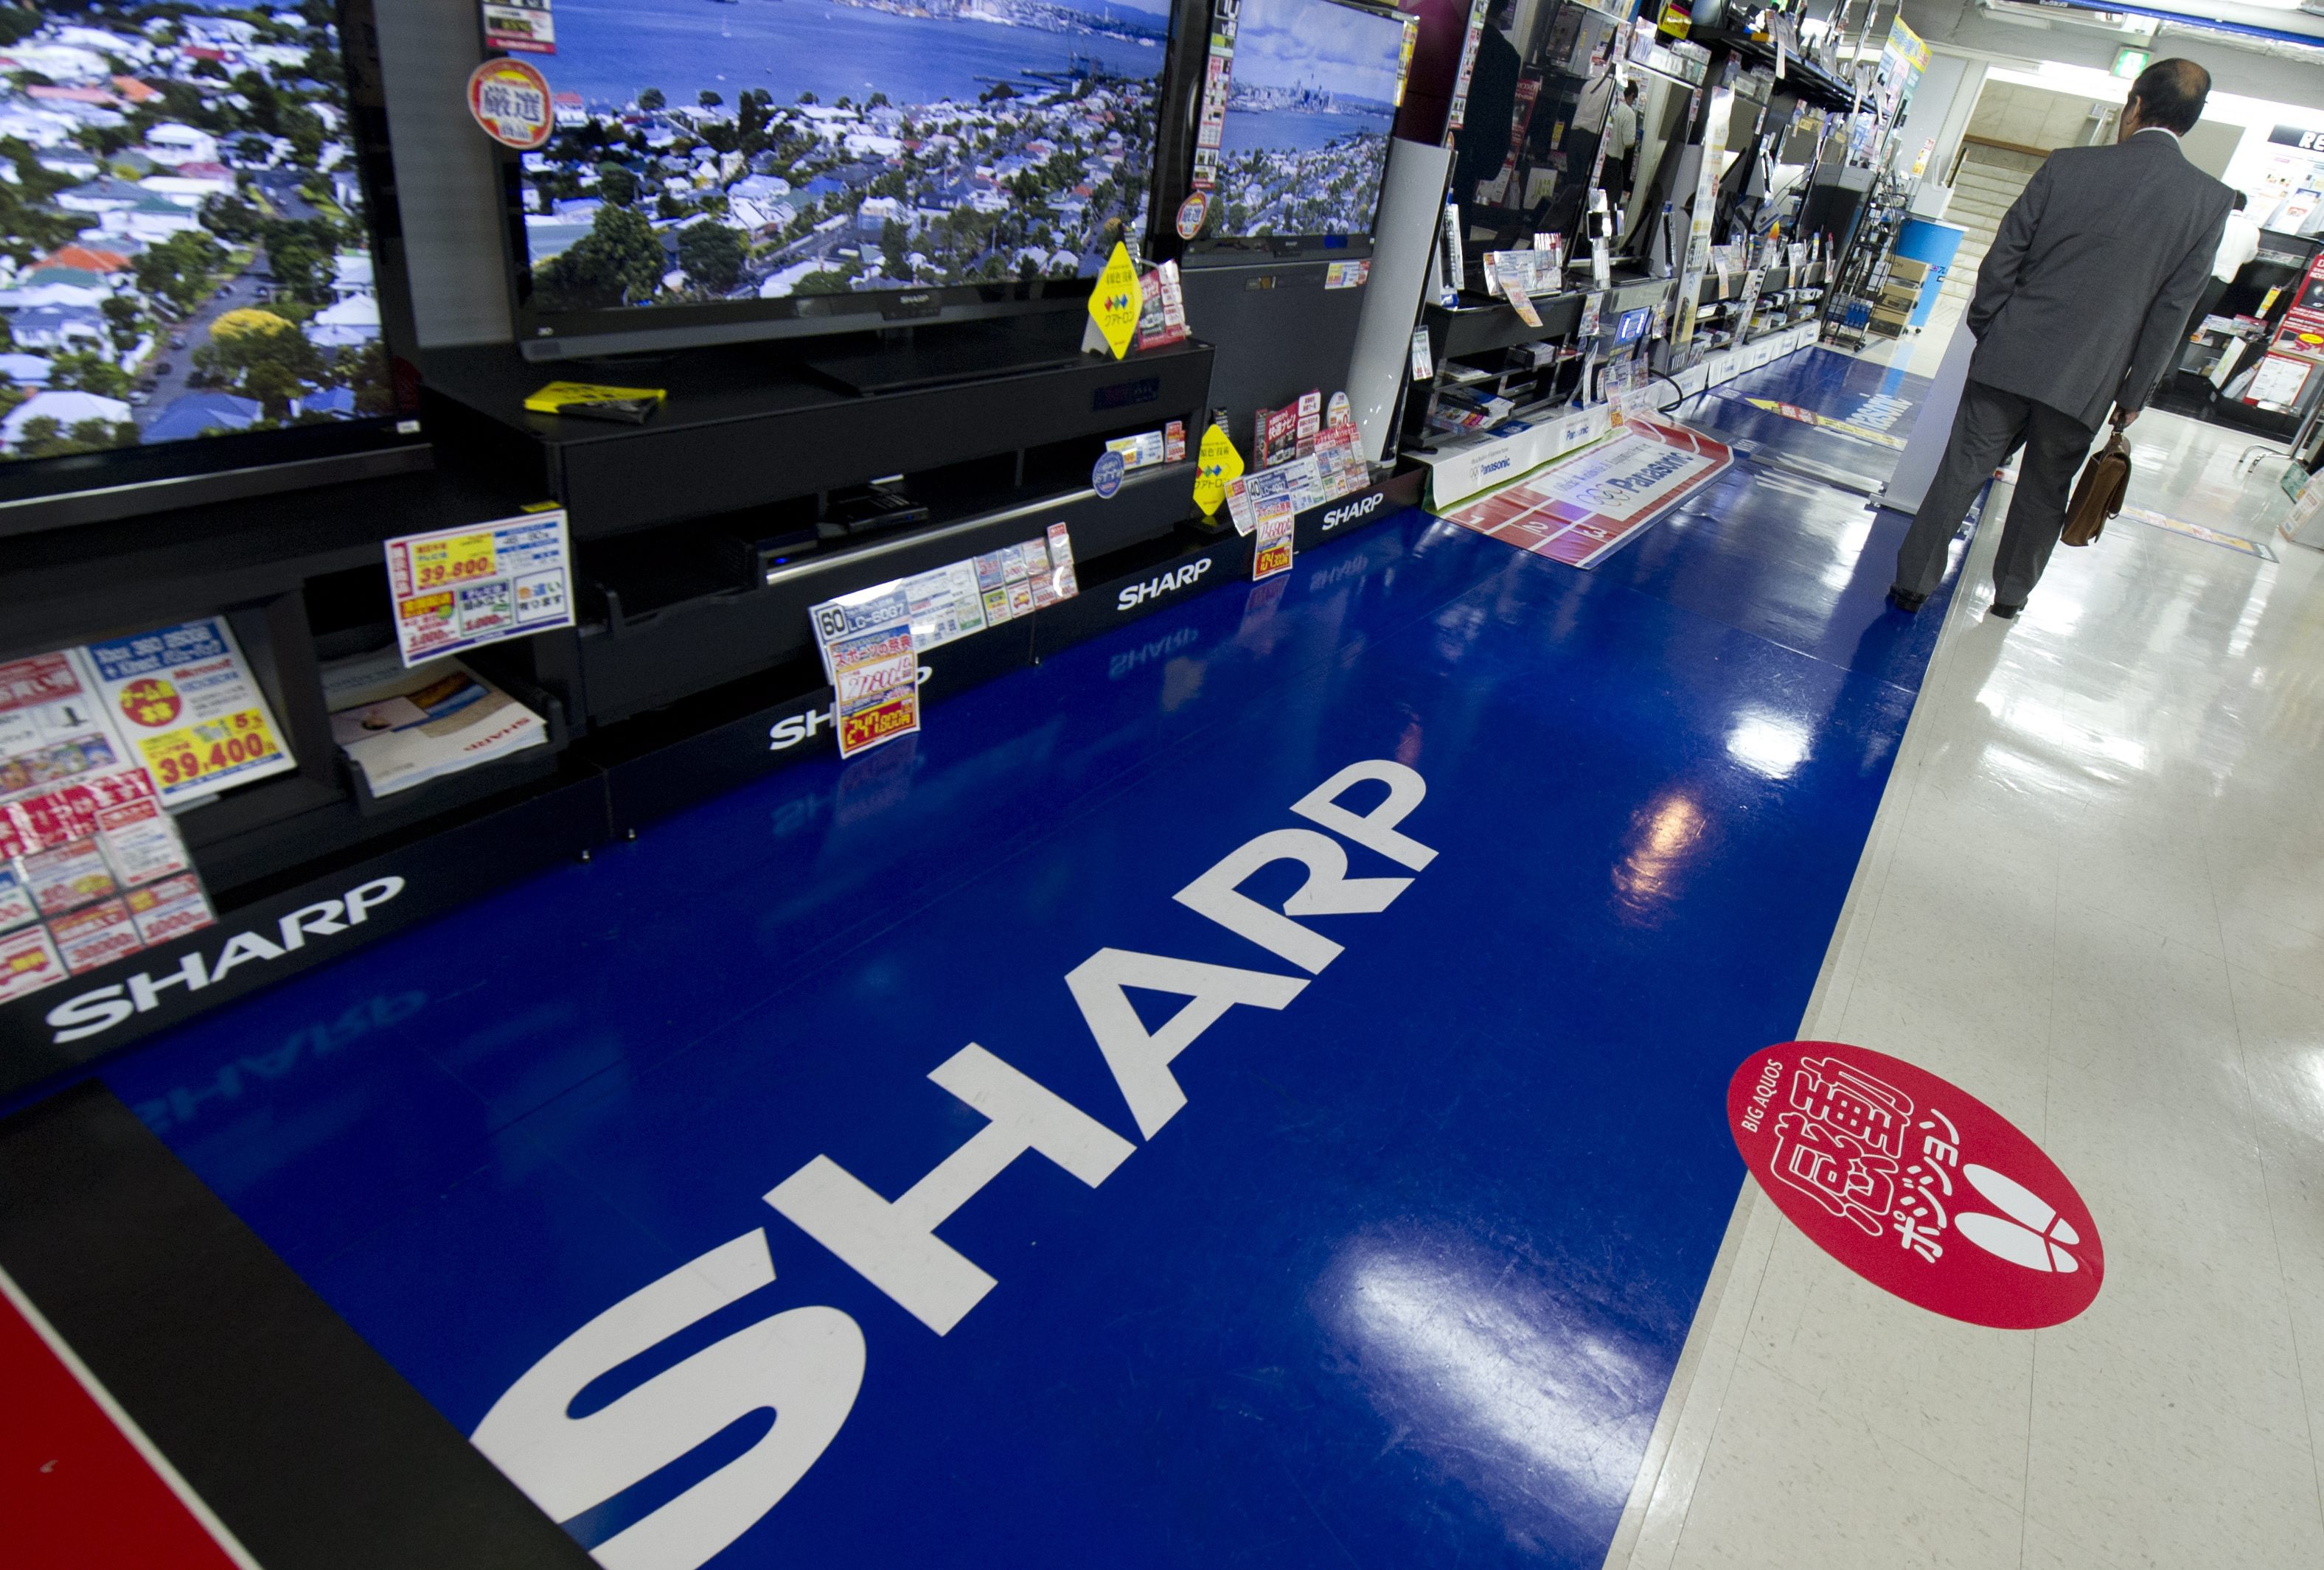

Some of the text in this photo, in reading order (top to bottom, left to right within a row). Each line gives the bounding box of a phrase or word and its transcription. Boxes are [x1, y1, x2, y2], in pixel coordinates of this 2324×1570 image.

[481, 82, 543, 124] 厳選
[1248, 480, 1261, 498] 40
[1610, 450, 1694, 494] Panasonic
[1322, 492, 1384, 531] SHARP
[1523, 520, 1548, 534] 2
[1584, 527, 1608, 539] 3
[1117, 558, 1212, 611] SHARP
[818, 607, 846, 635] 60
[45, 876, 405, 1044] SHARP
[1742, 1058, 1784, 1133] BIG AQUOS
[468, 759, 1439, 1570] SHARP
[1771, 1057, 1913, 1236] 感動
[1893, 1108, 1960, 1264] ポジション
